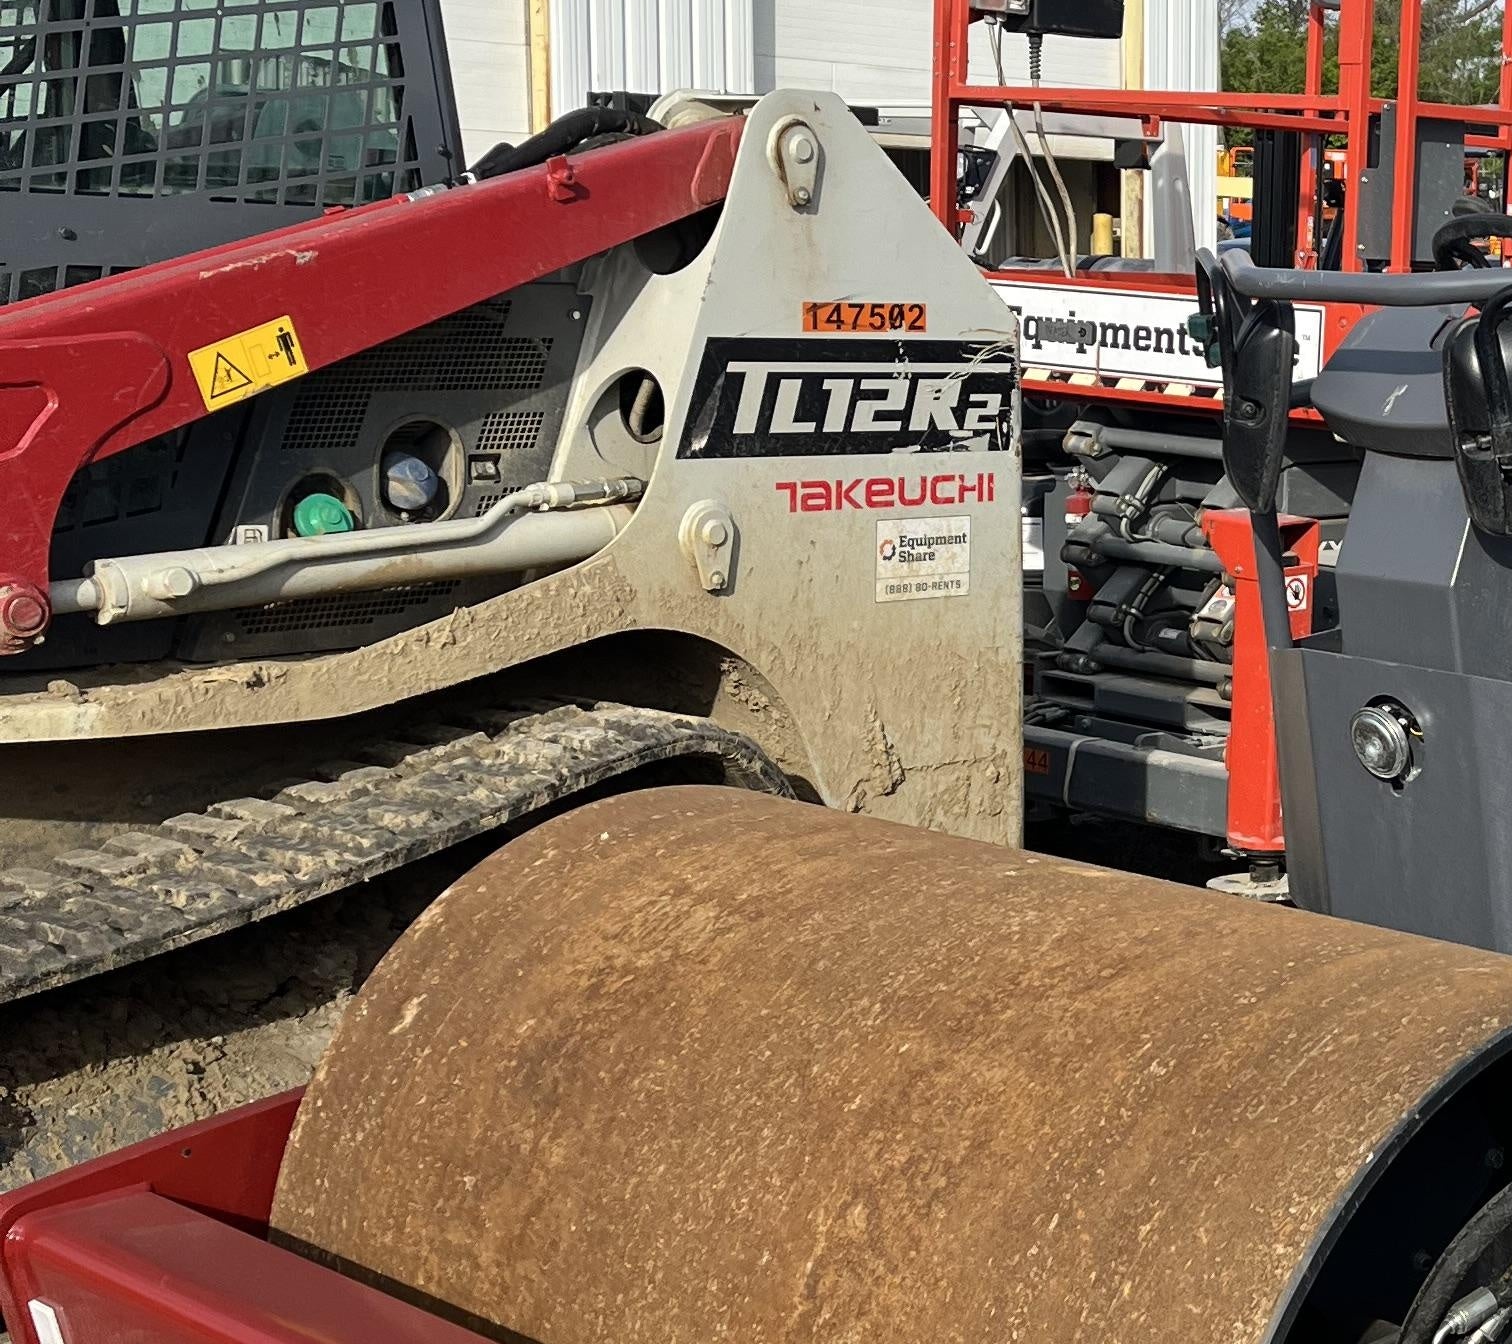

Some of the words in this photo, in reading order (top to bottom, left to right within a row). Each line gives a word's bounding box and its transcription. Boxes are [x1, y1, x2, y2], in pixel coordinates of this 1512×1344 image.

[804, 303, 926, 331] 147502
[898, 532, 968, 550] Equipment
[898, 550, 936, 563] Share
